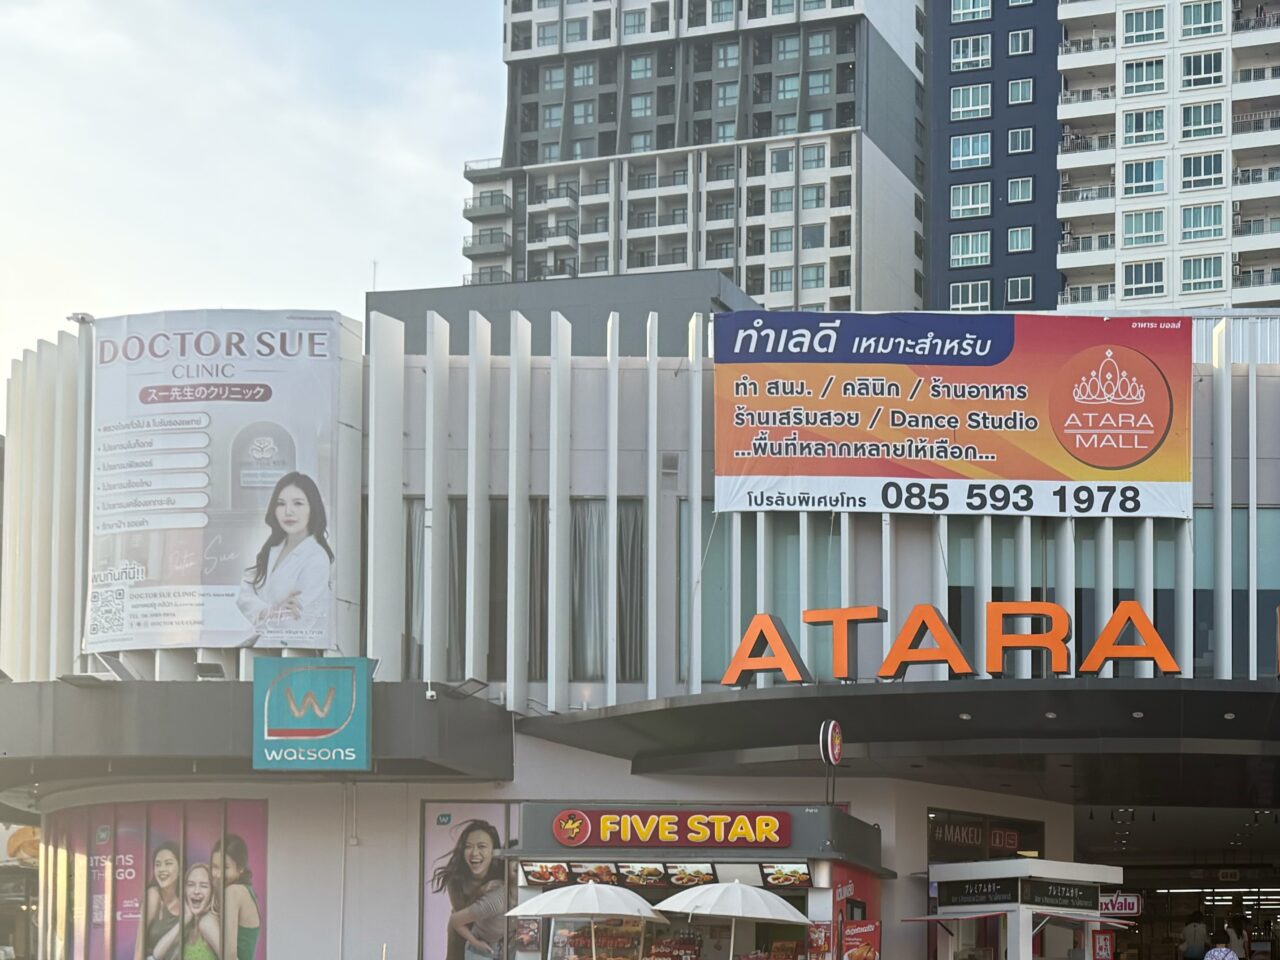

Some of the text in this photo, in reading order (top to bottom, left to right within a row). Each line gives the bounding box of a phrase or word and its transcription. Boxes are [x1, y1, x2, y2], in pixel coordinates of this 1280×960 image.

[99, 331, 328, 365] DOCTOR SUE
[734, 319, 992, 357] ทำเลดี เหมาะสำหรับ
[172, 364, 236, 379] CLINIC
[147, 385, 265, 401] スー先生のクリニック
[734, 377, 762, 397] ทำ
[842, 377, 901, 398] คลินิก
[930, 376, 1028, 400] ร้านอาหาร
[734, 405, 1040, 431] ร้านเสริมสวย Dance Studio
[1064, 412, 1154, 429] ATARA
[1075, 434, 1149, 449] MALL
[747, 481, 1142, 514] โปรลับพิเศษโทร 085 593 1978
[720, 599, 1181, 686] ATARA
[264, 746, 356, 762] watsons
[600, 815, 781, 843] FIVE STAR
[116, 868, 136, 880] GO
